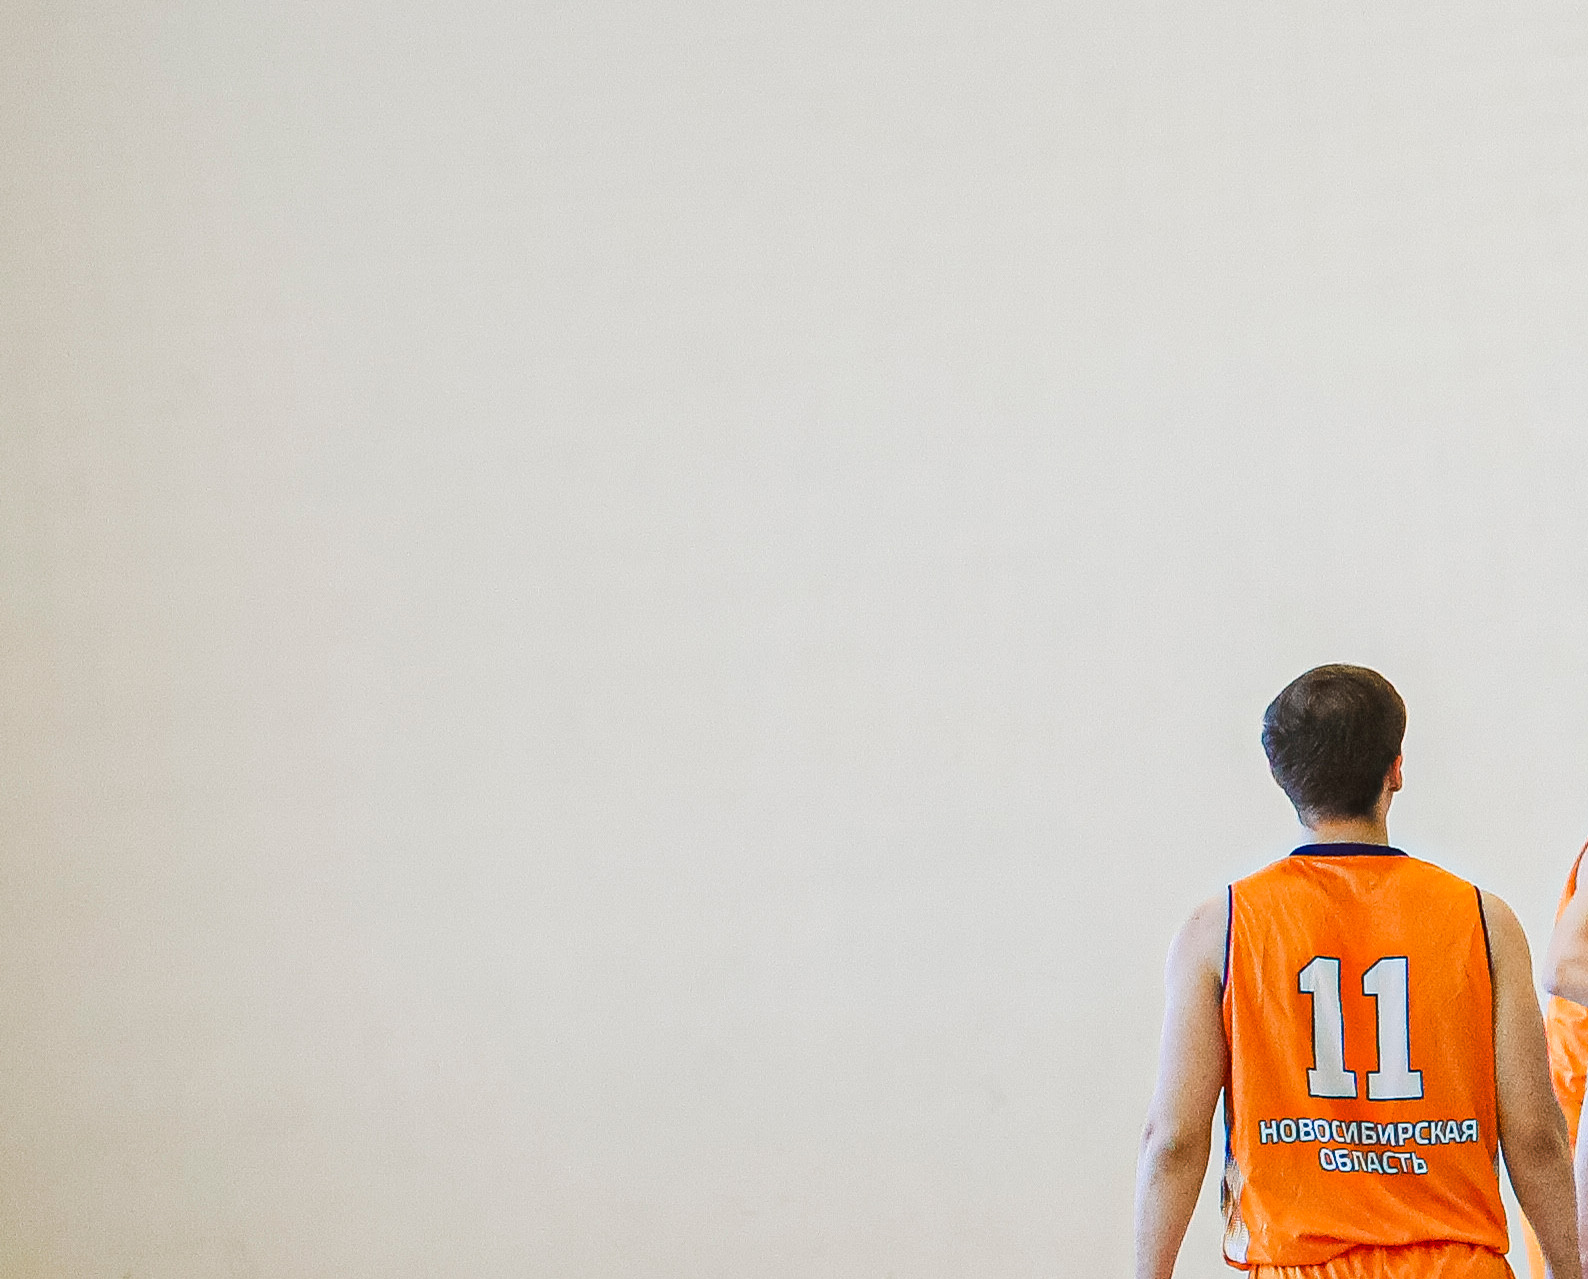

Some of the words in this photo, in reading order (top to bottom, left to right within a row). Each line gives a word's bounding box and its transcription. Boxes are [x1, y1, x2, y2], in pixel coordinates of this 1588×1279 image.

[1297, 955, 1425, 1102] 11
[1259, 1117, 1479, 1148] НОВОСИБИРСКАЯ
[1319, 1147, 1428, 1175] ОБЛАСТЬ
